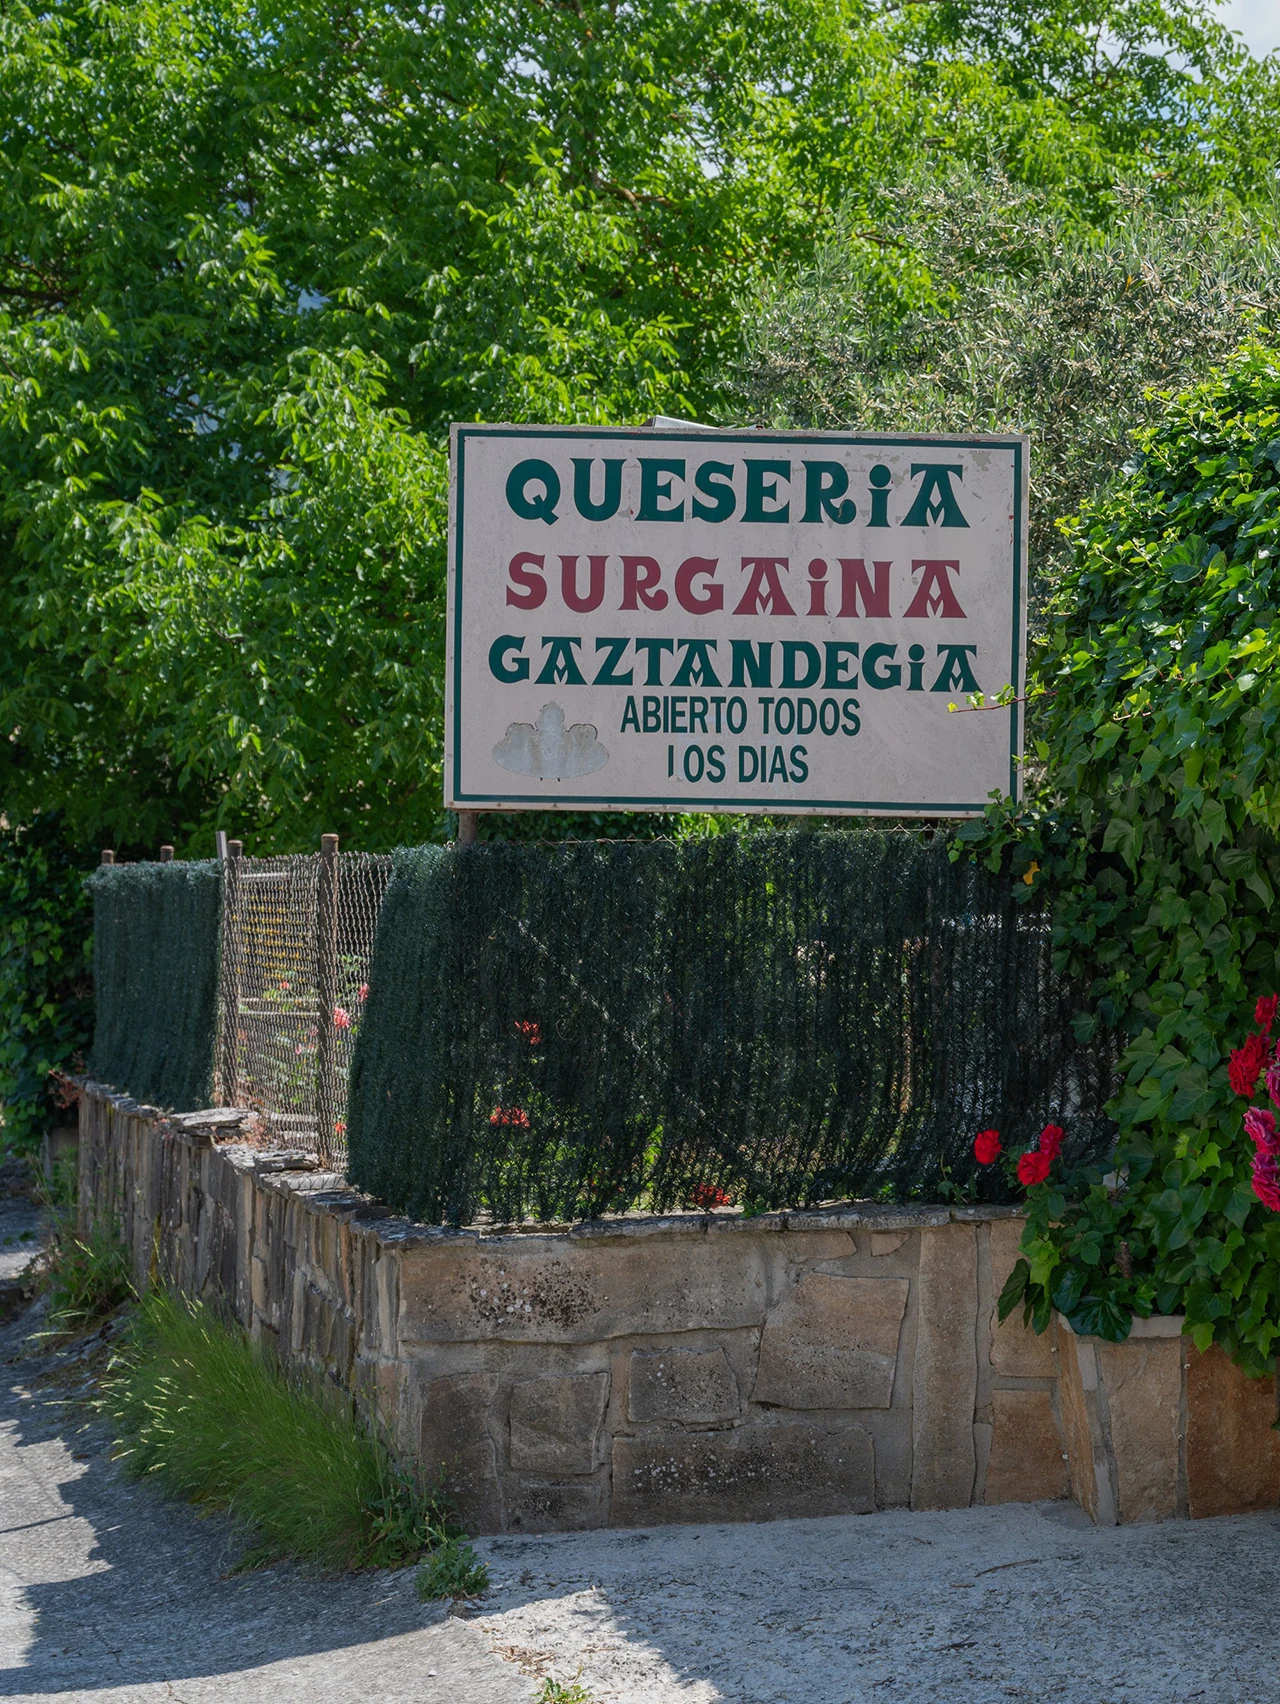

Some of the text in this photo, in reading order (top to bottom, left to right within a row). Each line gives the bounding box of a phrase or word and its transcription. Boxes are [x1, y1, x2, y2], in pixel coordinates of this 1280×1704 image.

[620, 695, 861, 737] ABIERTO TODOS
[739, 745, 809, 784] DIAS
